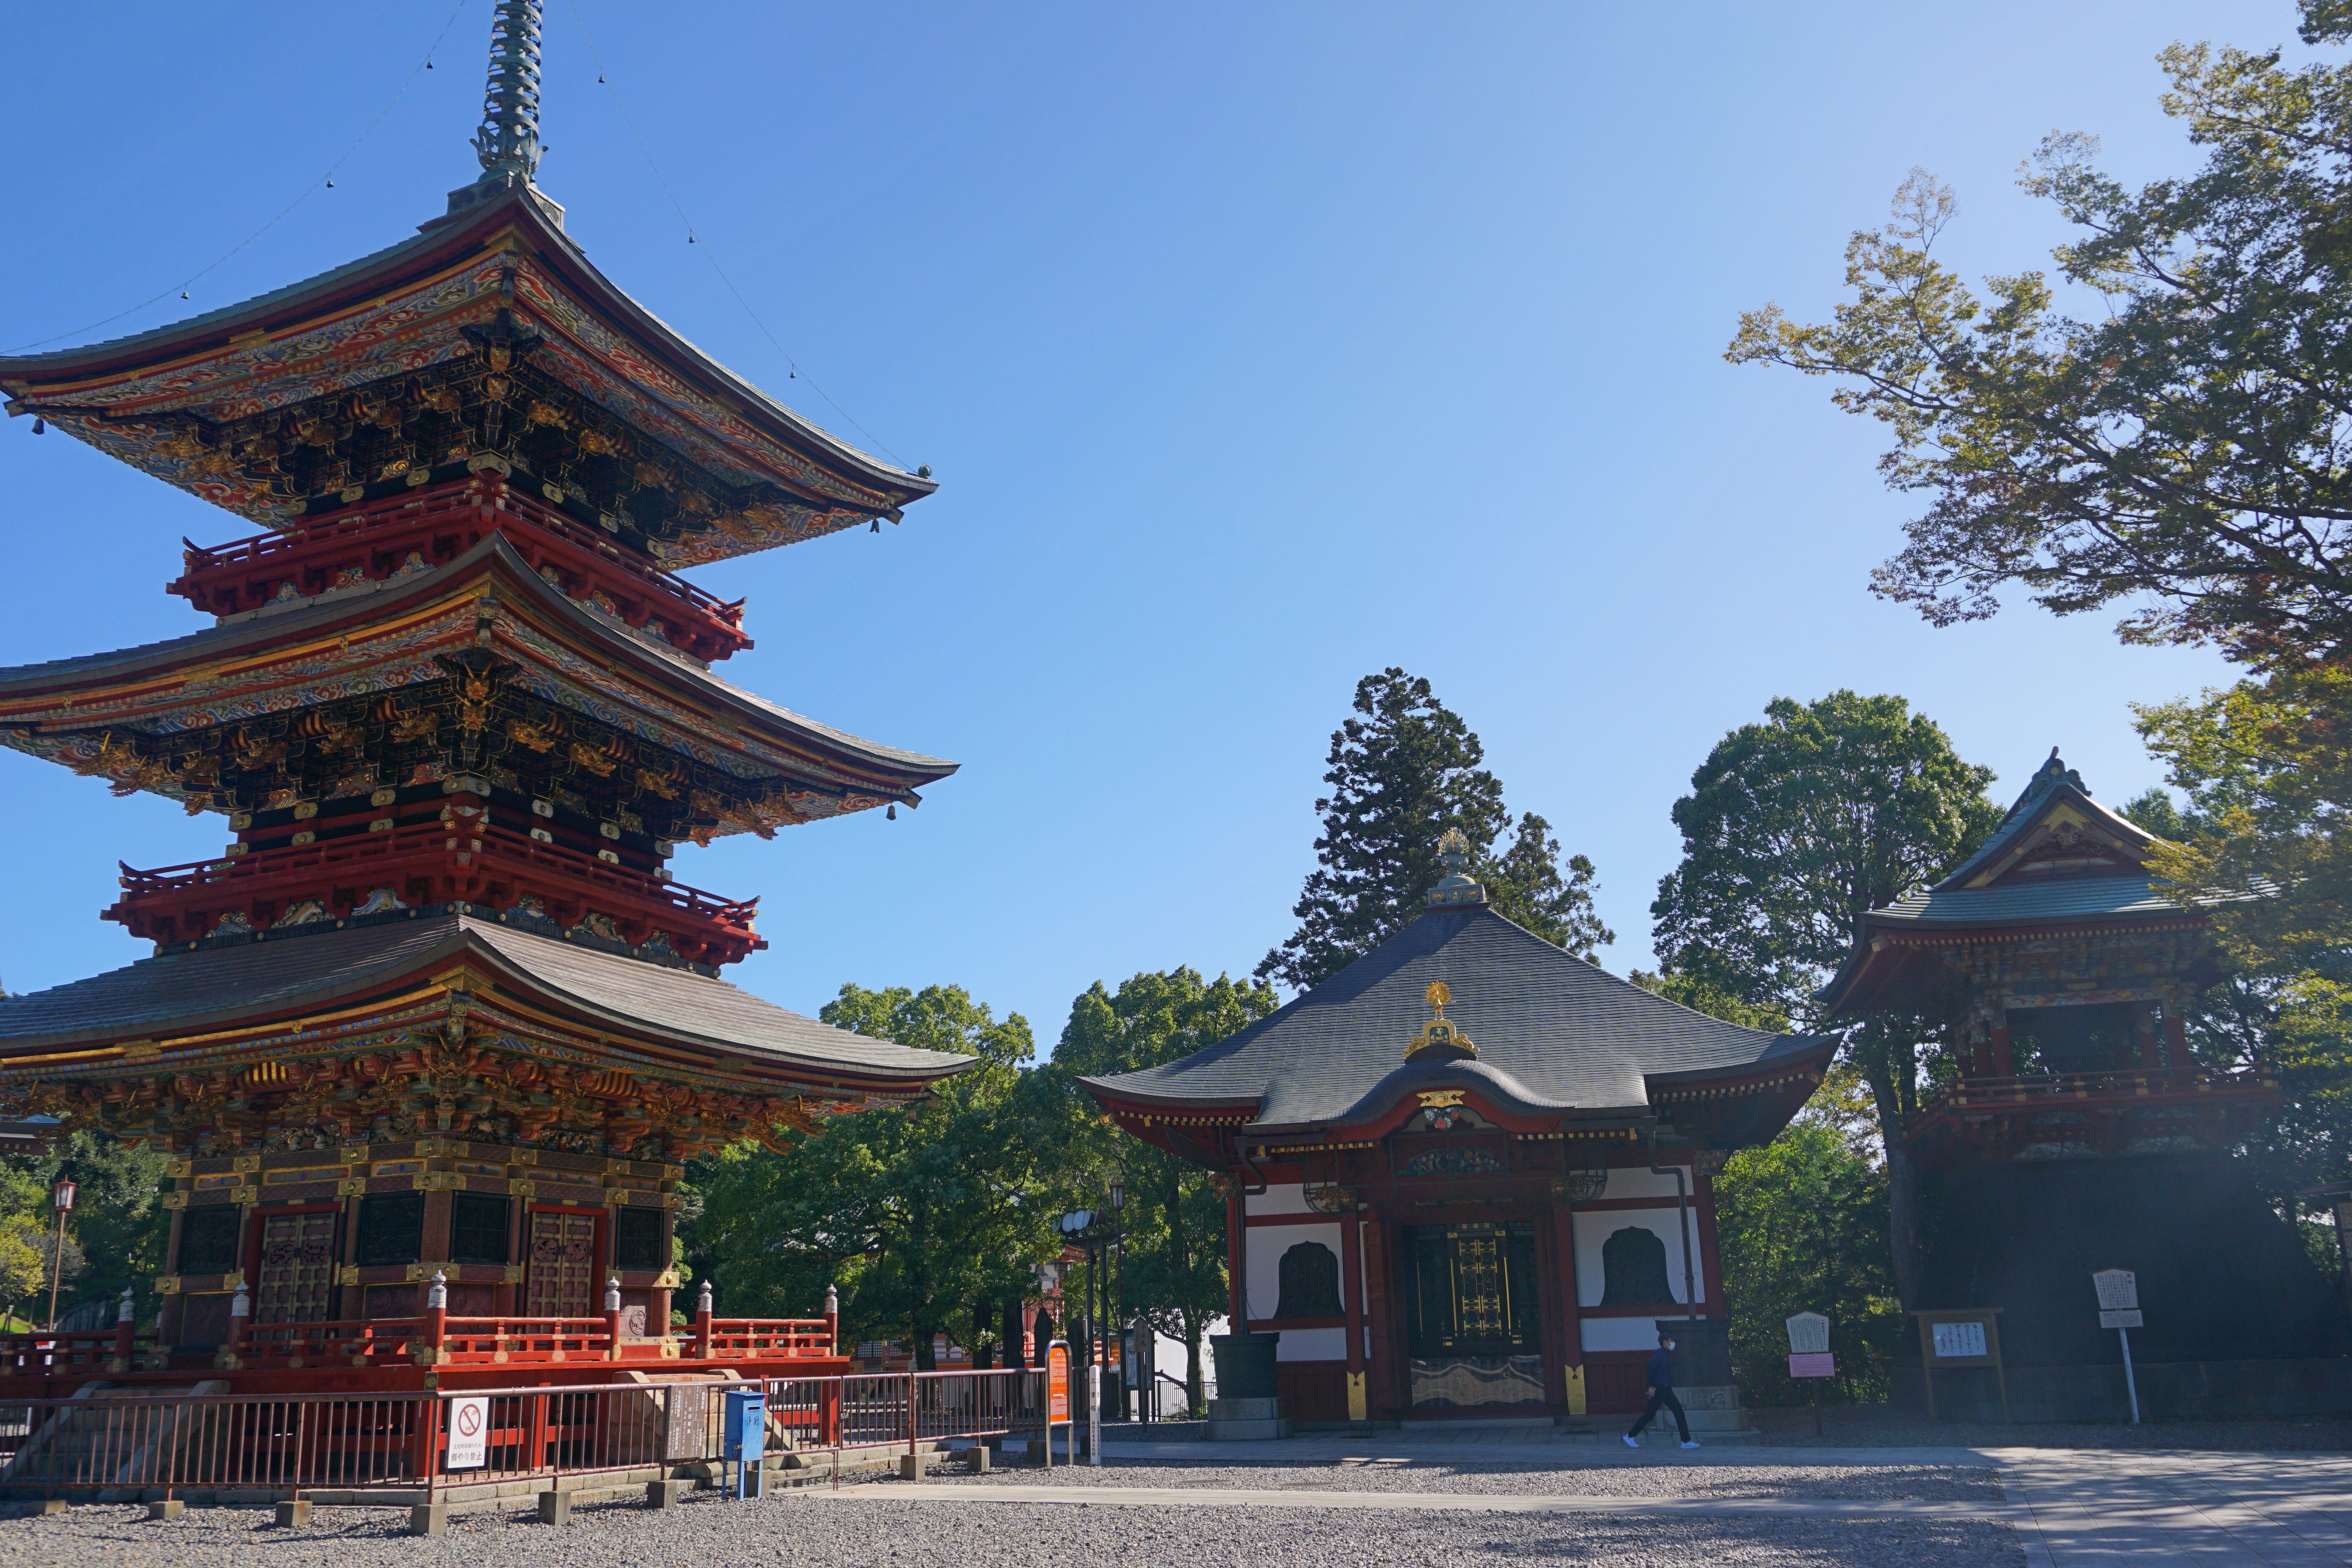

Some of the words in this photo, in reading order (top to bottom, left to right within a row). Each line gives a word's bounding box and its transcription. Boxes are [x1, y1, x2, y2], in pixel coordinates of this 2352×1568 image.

[451, 1452, 482, 1462] 餌やり禁止
